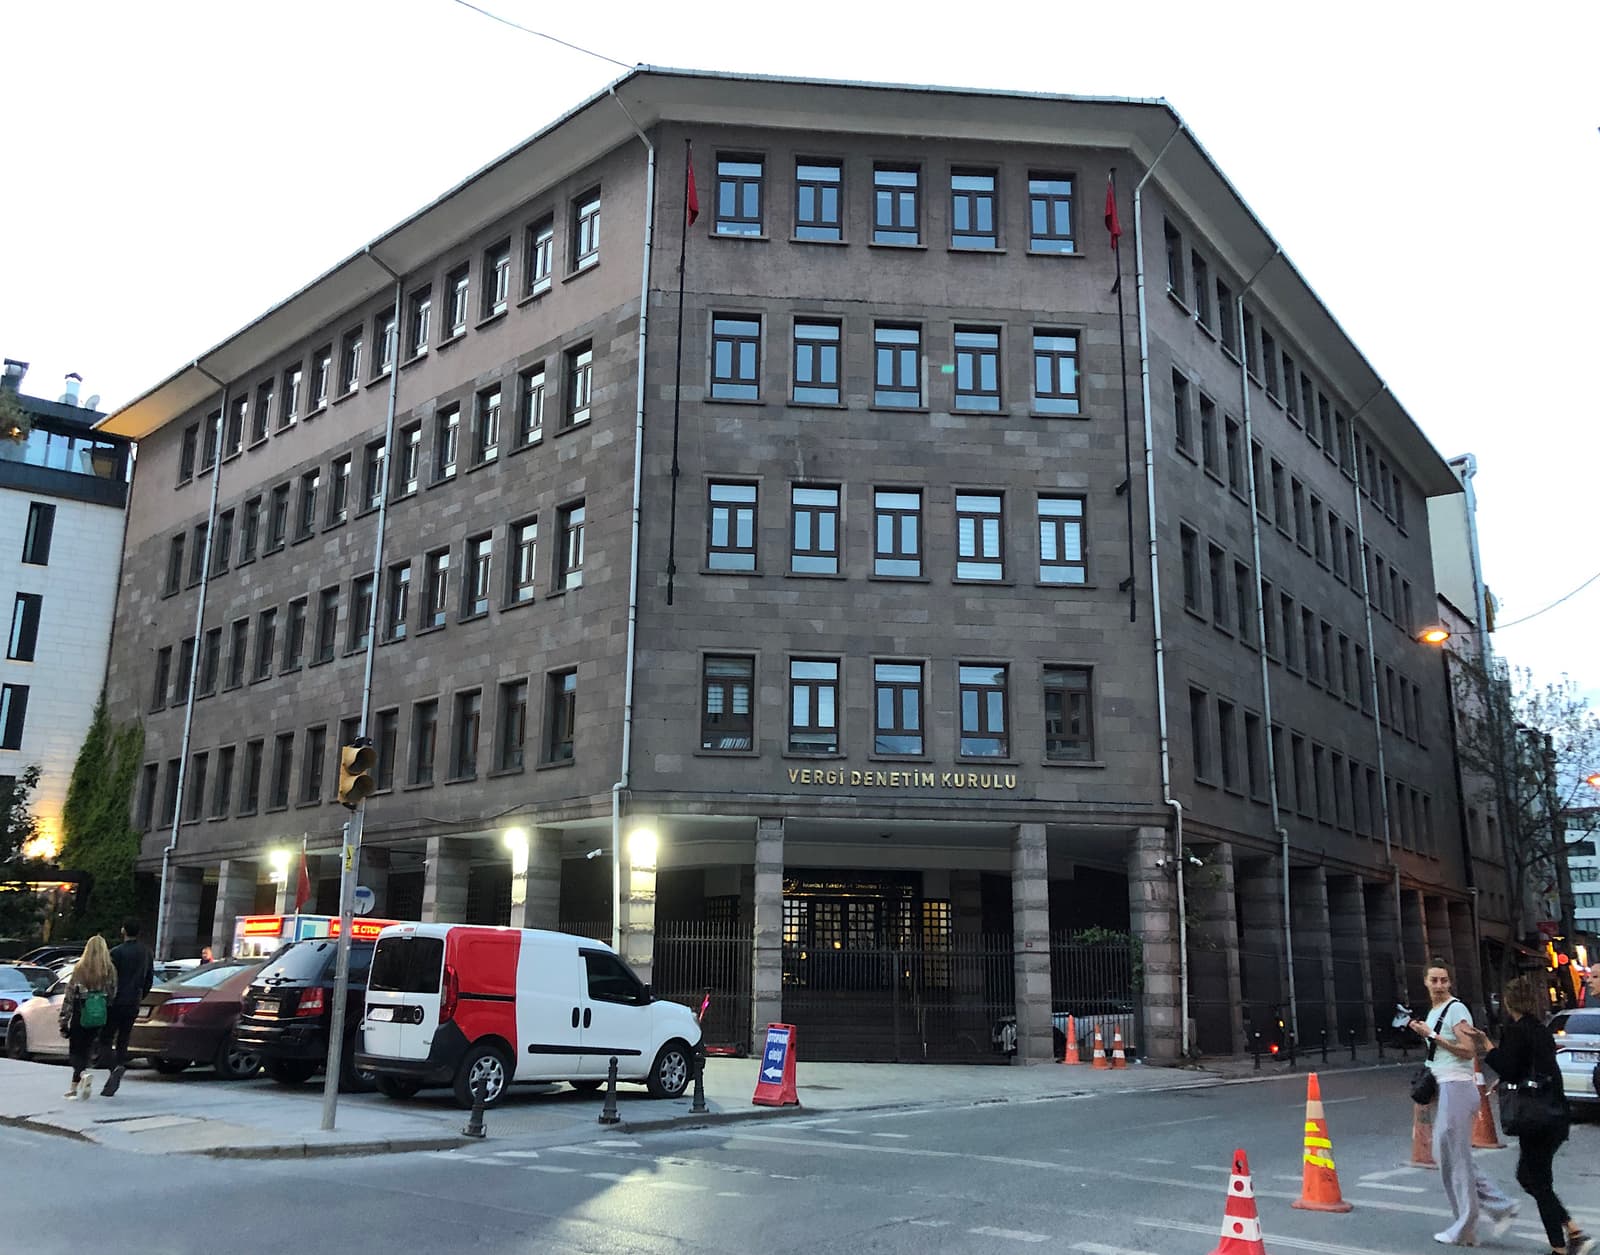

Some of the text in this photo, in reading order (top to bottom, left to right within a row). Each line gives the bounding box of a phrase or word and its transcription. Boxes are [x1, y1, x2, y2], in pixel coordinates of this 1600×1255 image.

[788, 767, 1017, 789] VERGİ DENETİM KURULU
